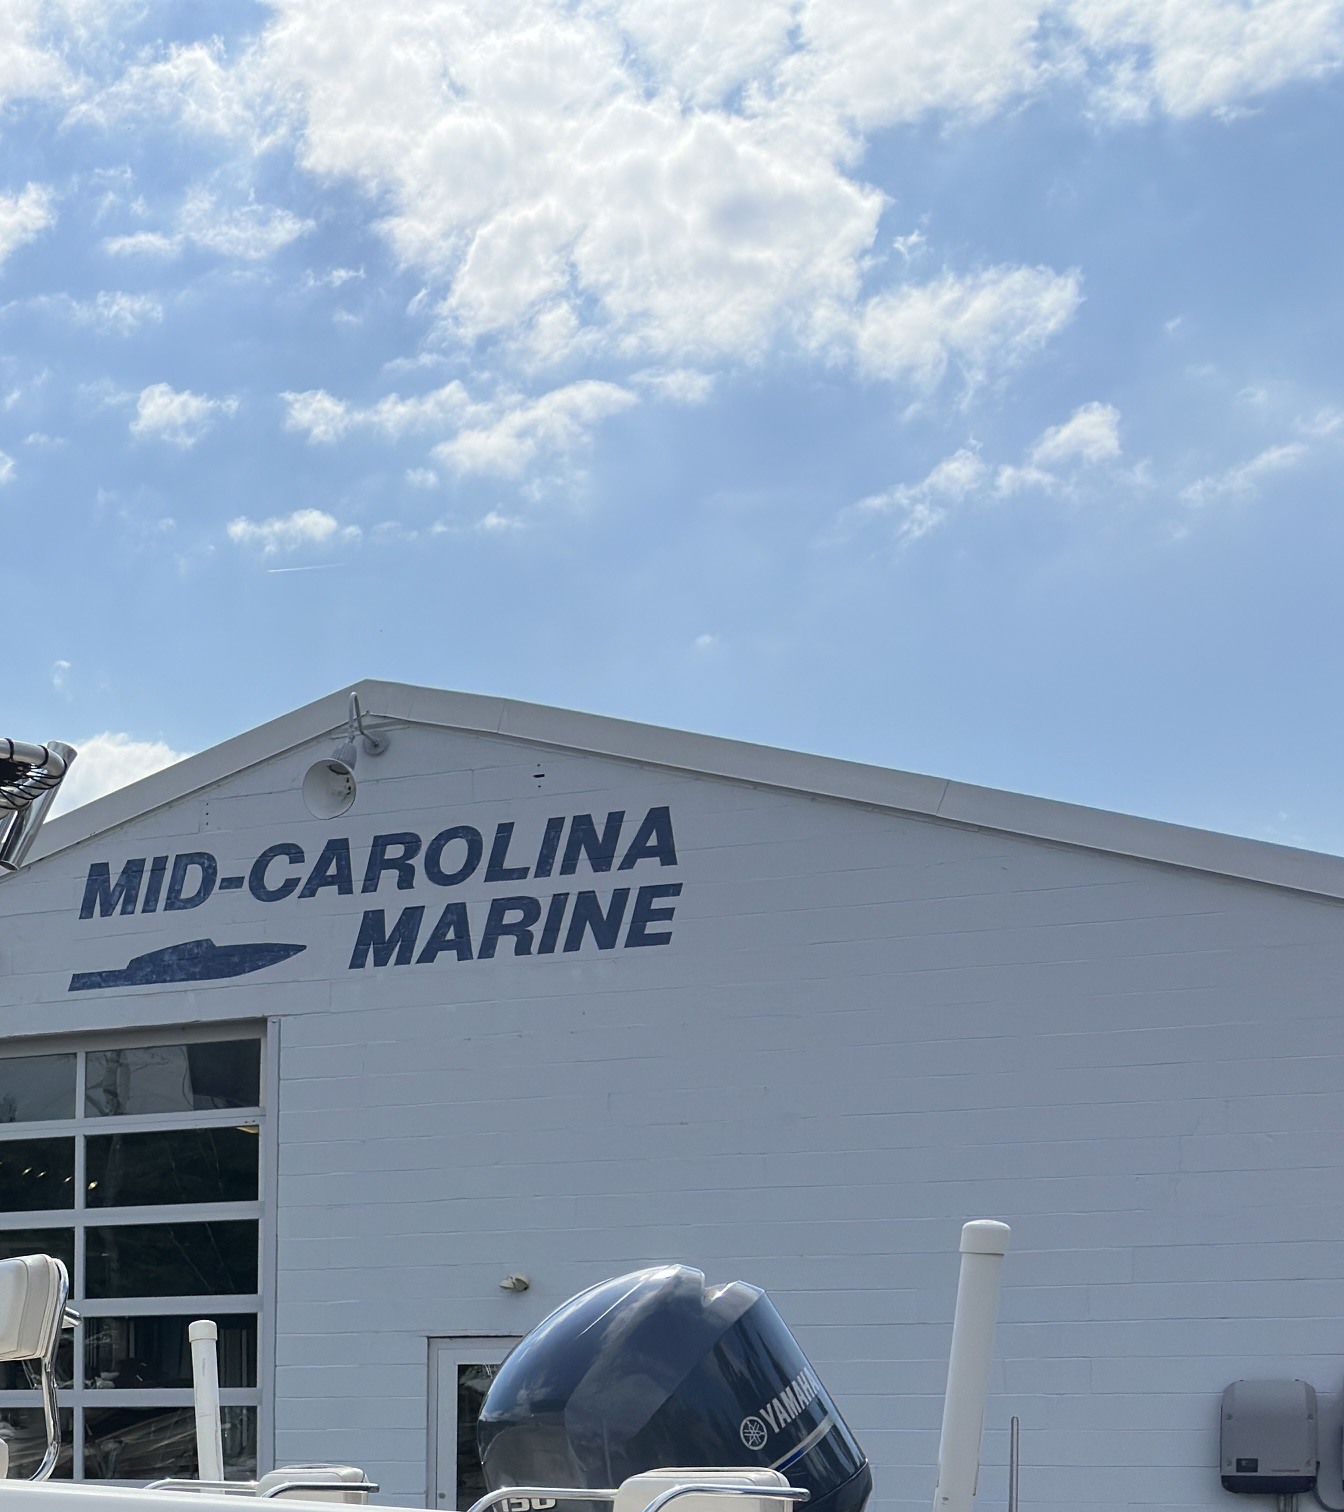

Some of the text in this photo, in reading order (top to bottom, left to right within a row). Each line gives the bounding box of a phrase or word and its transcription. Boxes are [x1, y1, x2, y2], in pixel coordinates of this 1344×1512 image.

[79, 806, 678, 920] MID-CAROLINA
[349, 882, 683, 970] MARINE
[758, 1366, 820, 1434] YAMAHA
